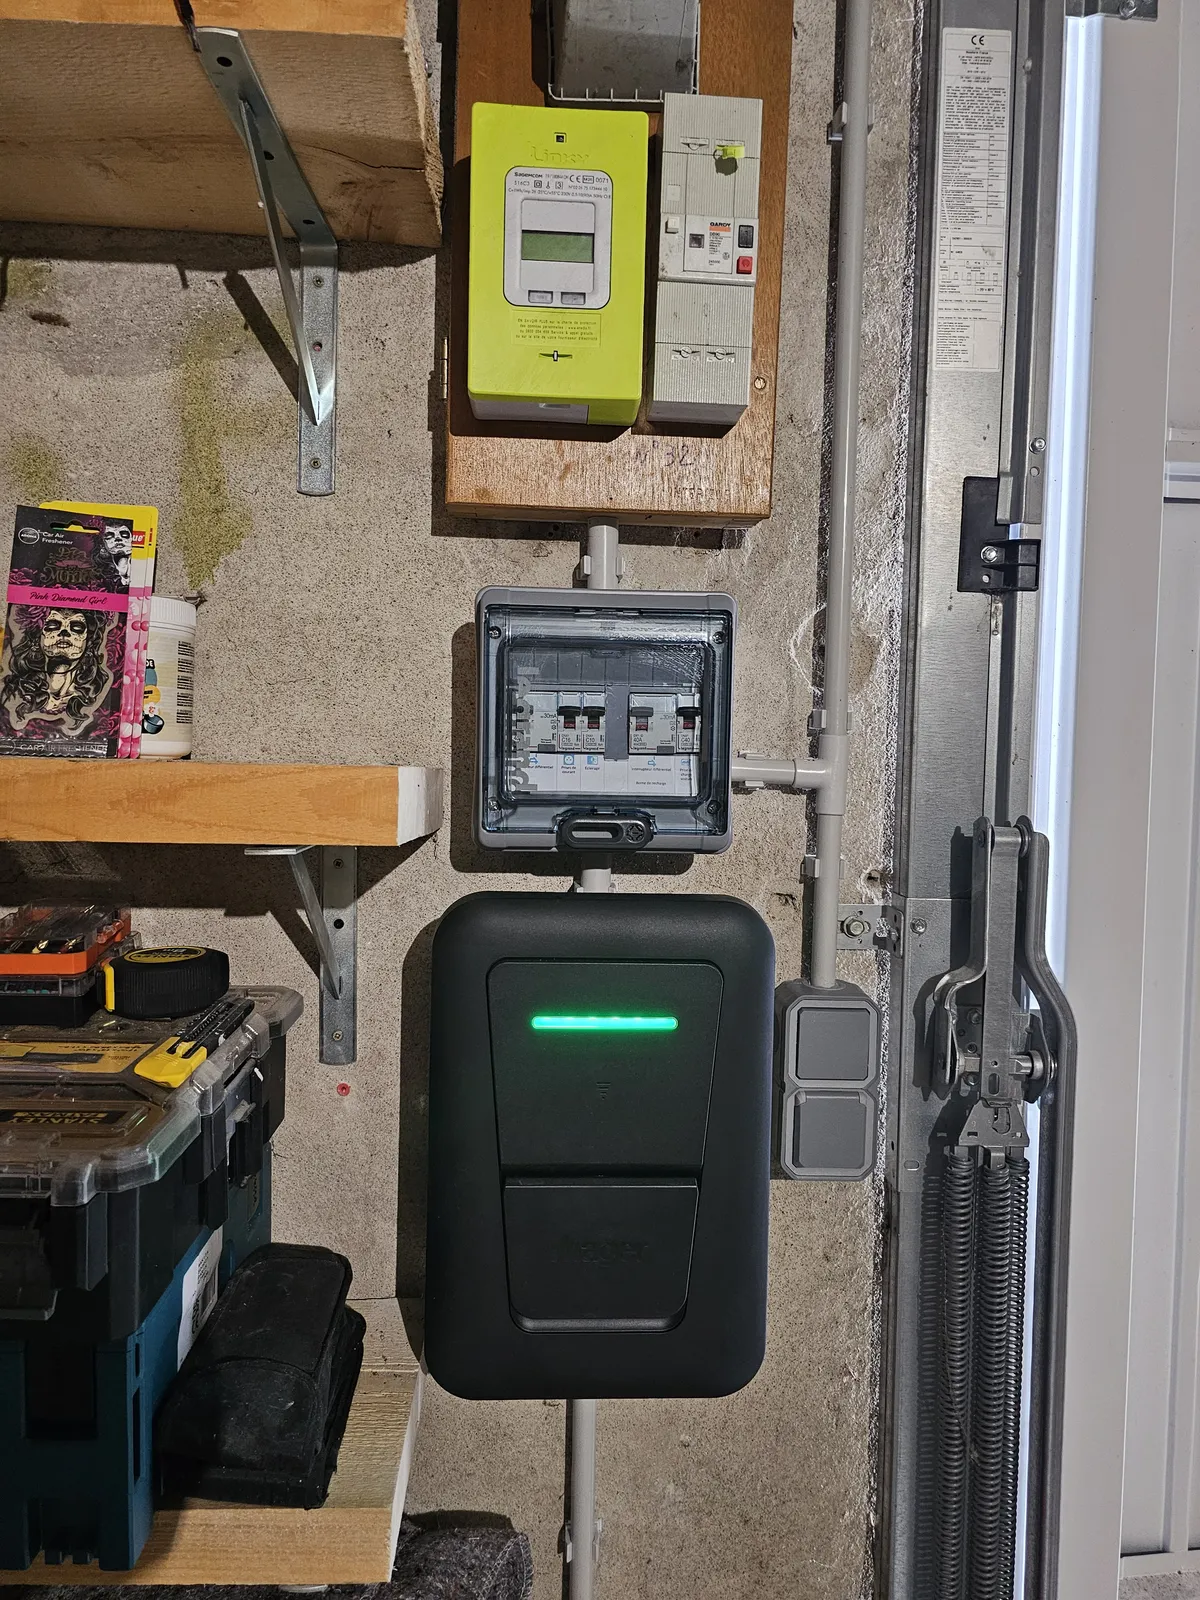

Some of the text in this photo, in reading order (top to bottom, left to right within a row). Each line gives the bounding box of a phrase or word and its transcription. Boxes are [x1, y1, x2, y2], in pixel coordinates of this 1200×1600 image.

[41, 537, 73, 545] Freshener
[30, 591, 108, 605] Pink Diamond Girl
